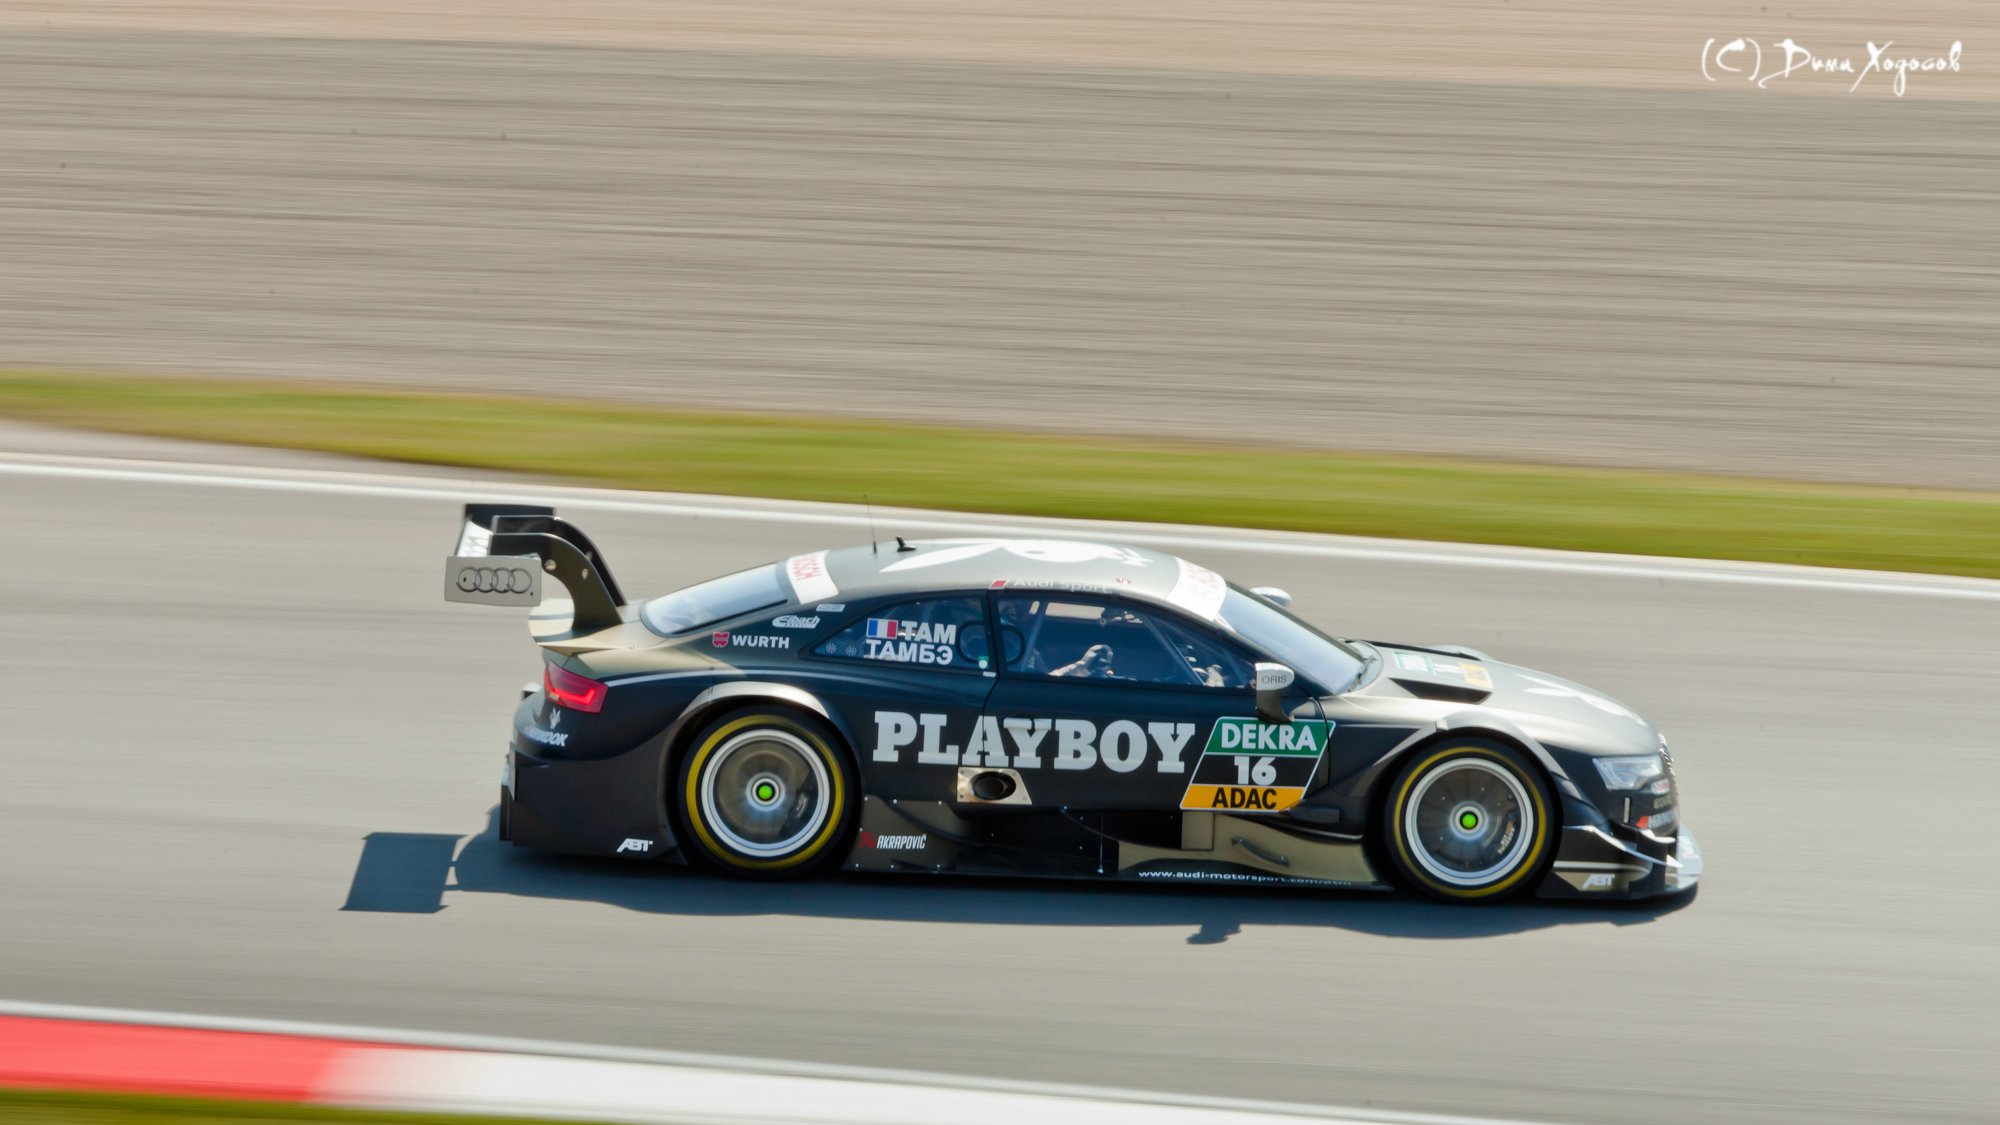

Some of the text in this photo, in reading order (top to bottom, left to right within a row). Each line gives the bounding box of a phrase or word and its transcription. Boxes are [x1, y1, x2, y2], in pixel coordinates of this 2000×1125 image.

[1014, 578, 1053, 588] Audi
[1262, 675, 1286, 685] ORIS
[872, 711, 1196, 773] PLAYBOY
[1221, 722, 1318, 753] DEKRA
[1234, 756, 1287, 786] 16
[1212, 787, 1277, 809] ADAC
[616, 838, 654, 853] ABT
[1582, 873, 1615, 890] ABT
